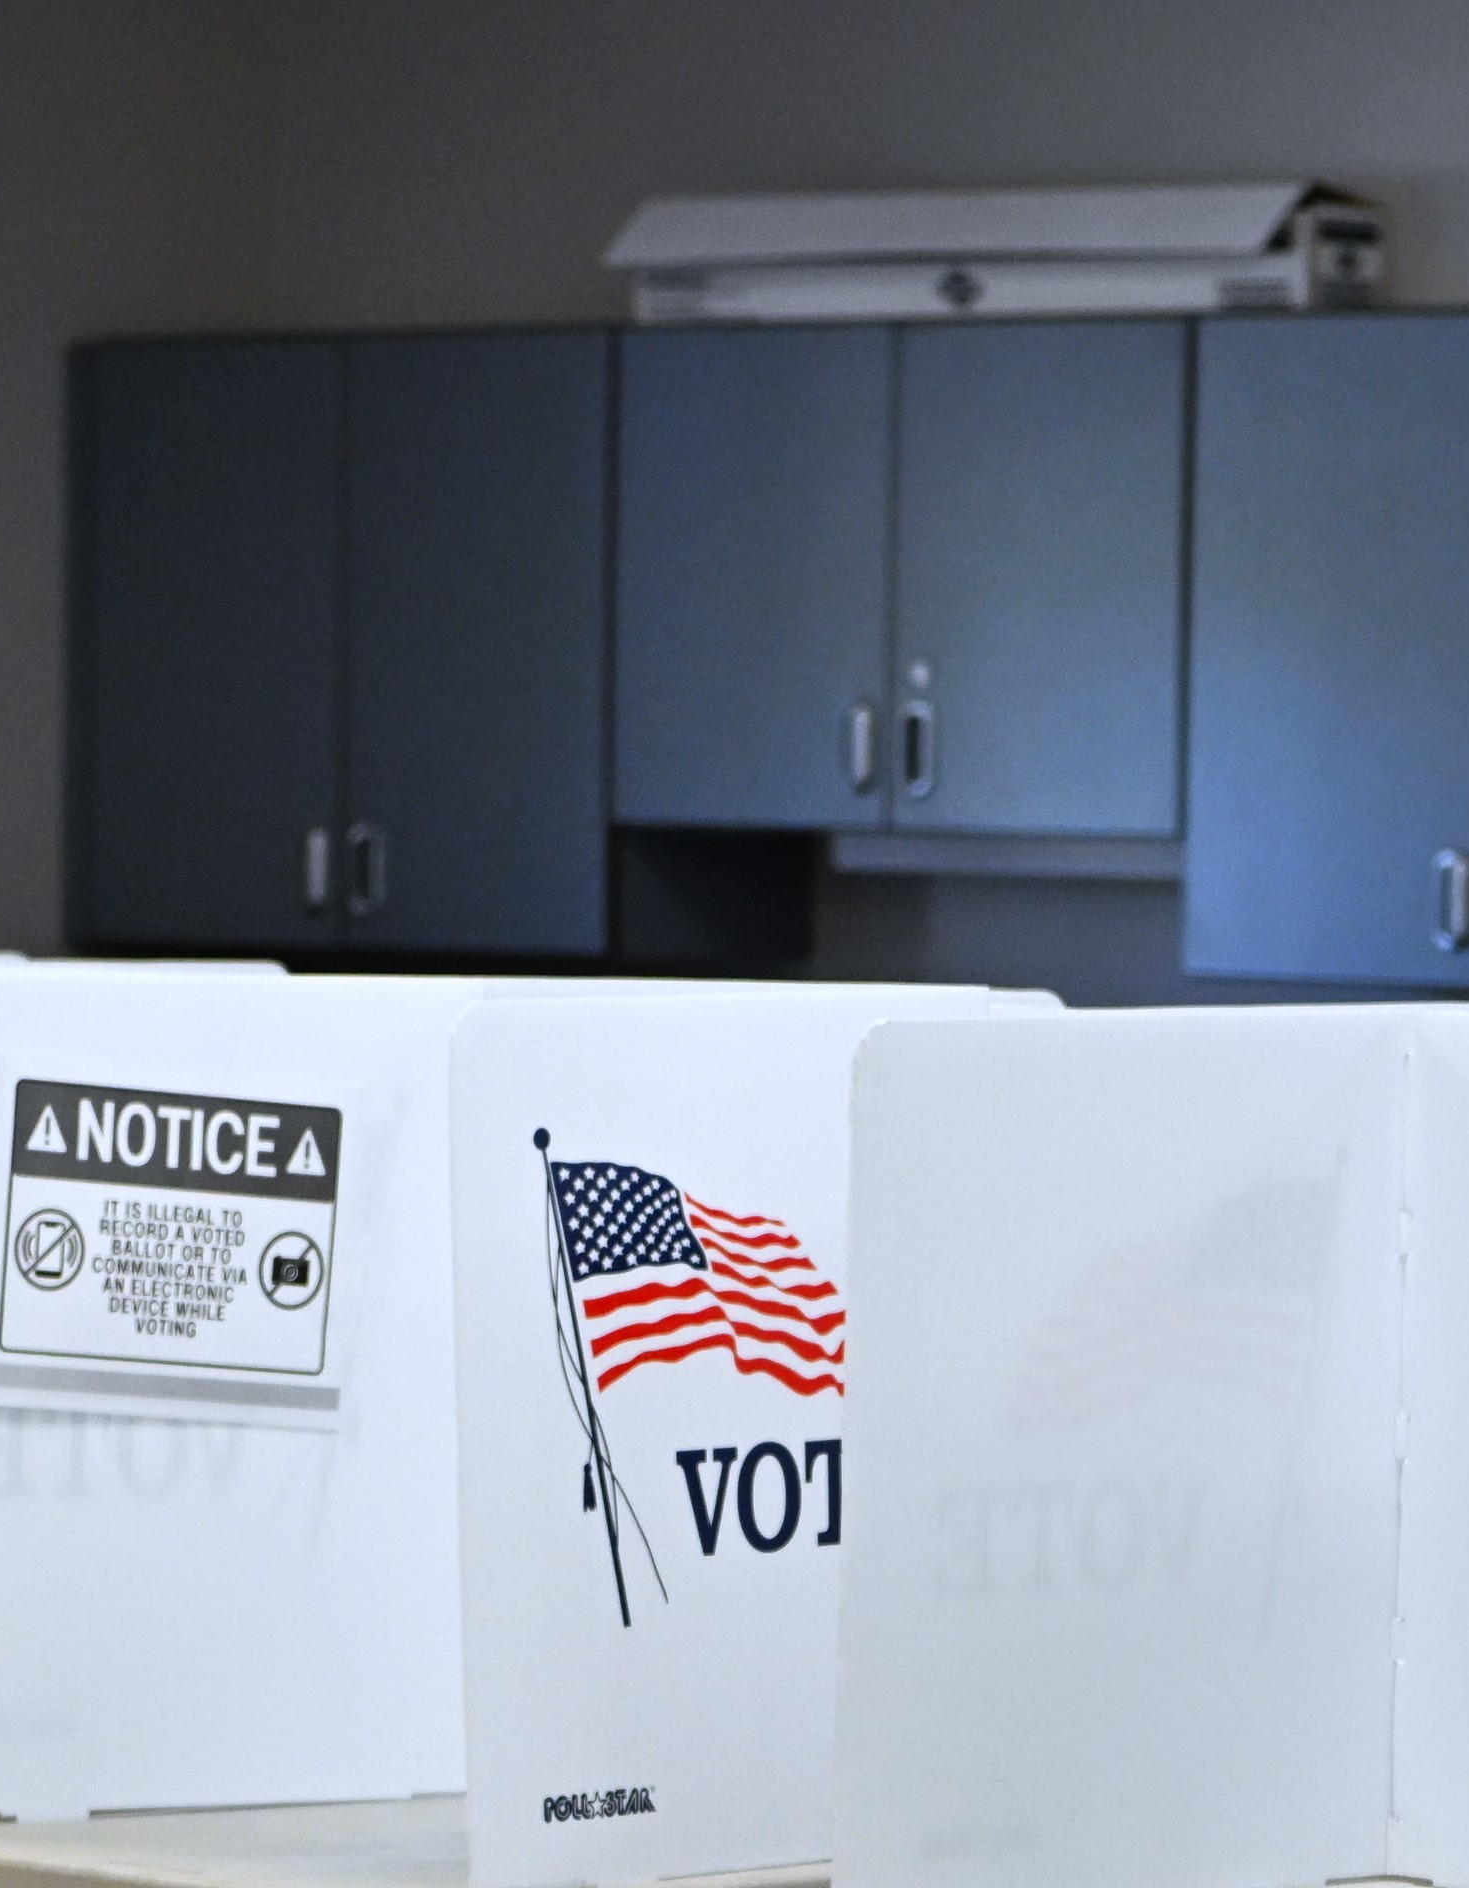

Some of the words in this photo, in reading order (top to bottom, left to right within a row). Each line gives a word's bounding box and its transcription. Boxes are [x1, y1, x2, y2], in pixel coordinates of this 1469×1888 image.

[76, 1097, 280, 1178] NOTICE
[104, 1200, 119, 1217] IT
[125, 1202, 141, 1219] IS
[147, 1203, 214, 1225] ILLEGAL
[222, 1210, 243, 1228] TO
[100, 1219, 169, 1240] RECORD
[176, 1226, 184, 1241] A
[192, 1228, 245, 1247] VOTED
[112, 1239, 176, 1259] BALLOT
[183, 1246, 204, 1261] OR
[211, 1247, 231, 1264] TO
[93, 1257, 215, 1282] COMMUNICATE
[222, 1267, 247, 1285] VIA
[103, 1277, 124, 1293] AN
[132, 1279, 235, 1303] ELECTRONIC
[109, 1297, 170, 1317] DEVICE
[176, 1303, 226, 1321] WHILE
[135, 1318, 197, 1338] VOTING
